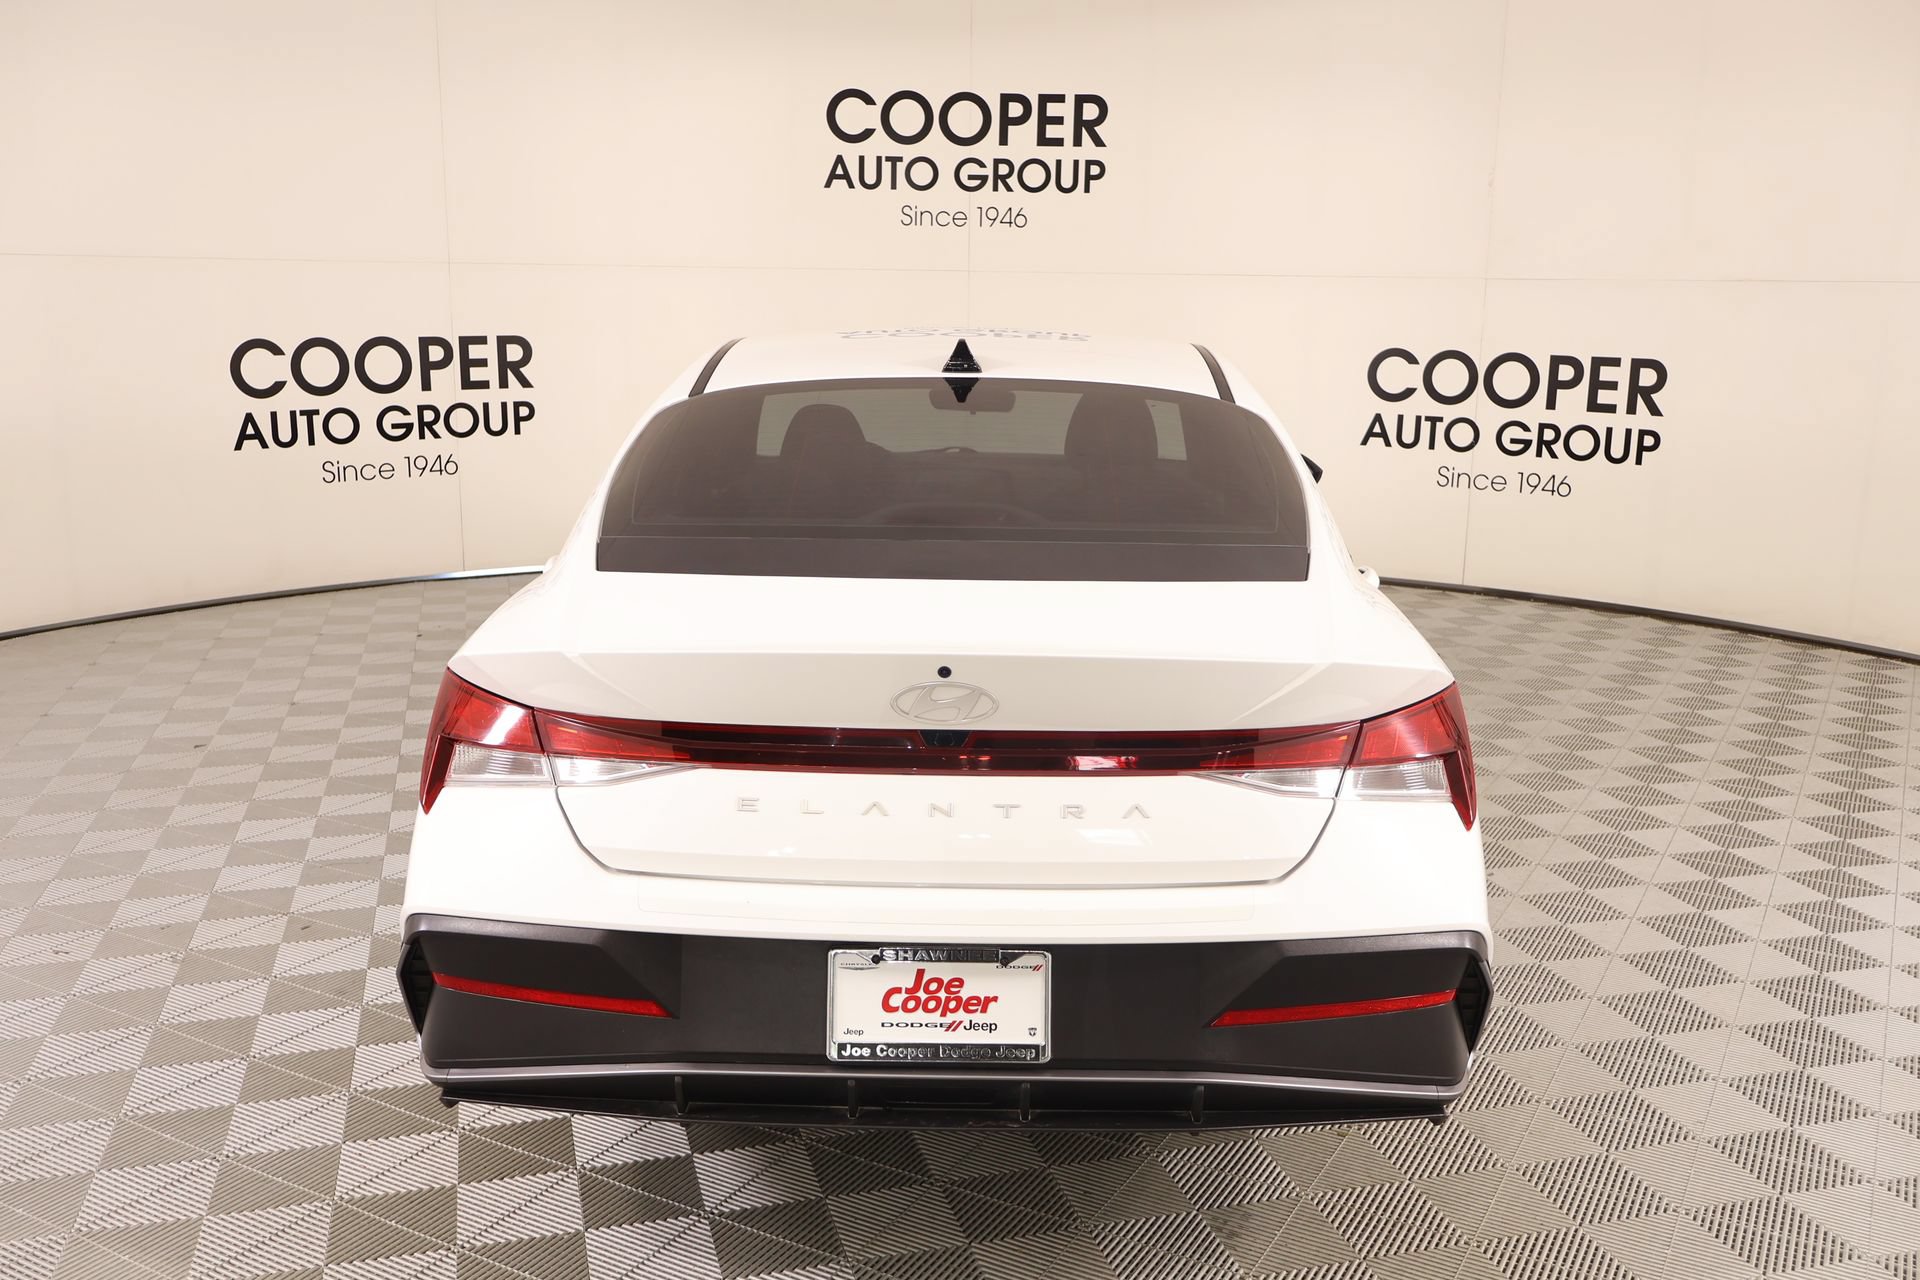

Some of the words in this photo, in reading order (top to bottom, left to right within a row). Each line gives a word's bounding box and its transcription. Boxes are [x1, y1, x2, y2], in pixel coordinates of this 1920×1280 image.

[826, 88, 1109, 147] COOPER
[824, 154, 939, 191] AUTO
[954, 157, 1106, 194] GROUP
[900, 204, 968, 227] Since
[976, 206, 1028, 228] 1946
[229, 335, 535, 399] COOPER
[1367, 347, 1668, 417] COOPER
[233, 407, 360, 451] AUTO
[376, 400, 536, 442] GROUP
[1360, 413, 1480, 453] AUTO
[1495, 420, 1661, 465] GROUP
[322, 460, 395, 484] Since
[404, 453, 459, 477] 1946
[1437, 466, 1507, 492] Since
[1517, 471, 1572, 497] 1946
[735, 797, 1151, 819] ELANTRA
[882, 949, 997, 961] SHAWNEE
[904, 968, 965, 996] Joe
[881, 986, 999, 1018] Cooper
[843, 1027, 865, 1036] Jeep
[881, 1021, 952, 1029] DODGE
[963, 1019, 998, 1033] Jeep
[841, 1044, 871, 1057] Joe
[876, 1044, 936, 1060] Cooper
[940, 1044, 991, 1060] Dodge
[995, 1045, 1036, 1060] Jeep
